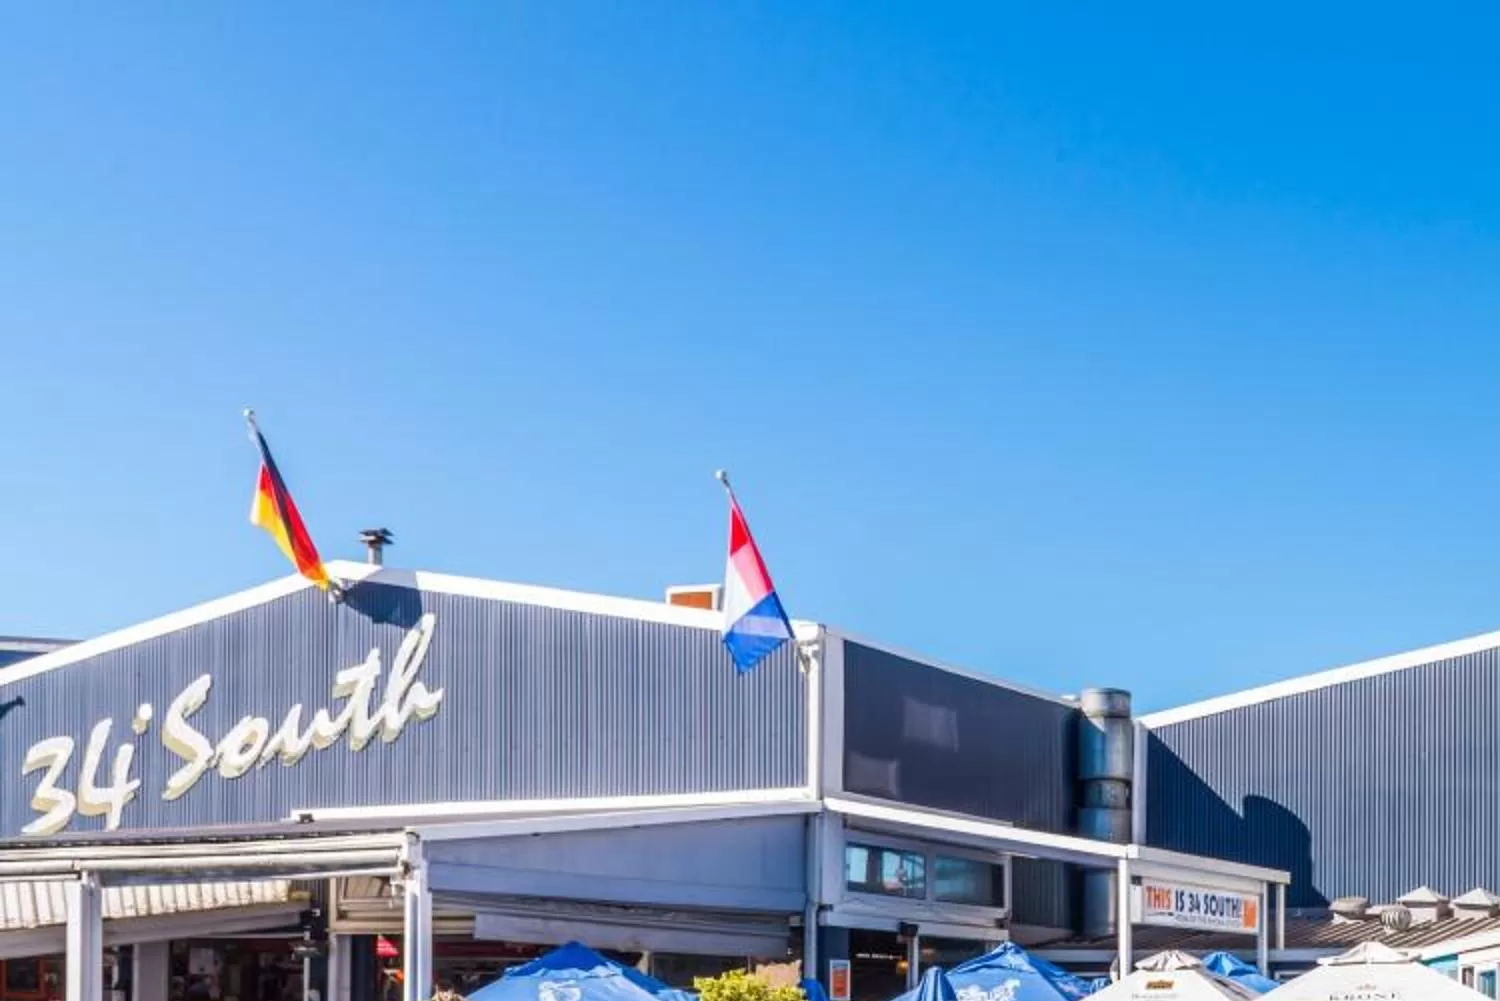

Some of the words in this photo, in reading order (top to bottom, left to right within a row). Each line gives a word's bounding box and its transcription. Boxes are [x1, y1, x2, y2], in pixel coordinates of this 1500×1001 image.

[162, 613, 444, 801] South
[1146, 885, 1171, 910] THIS
[1175, 888, 1185, 912] IS
[1188, 892, 1201, 914] 34
